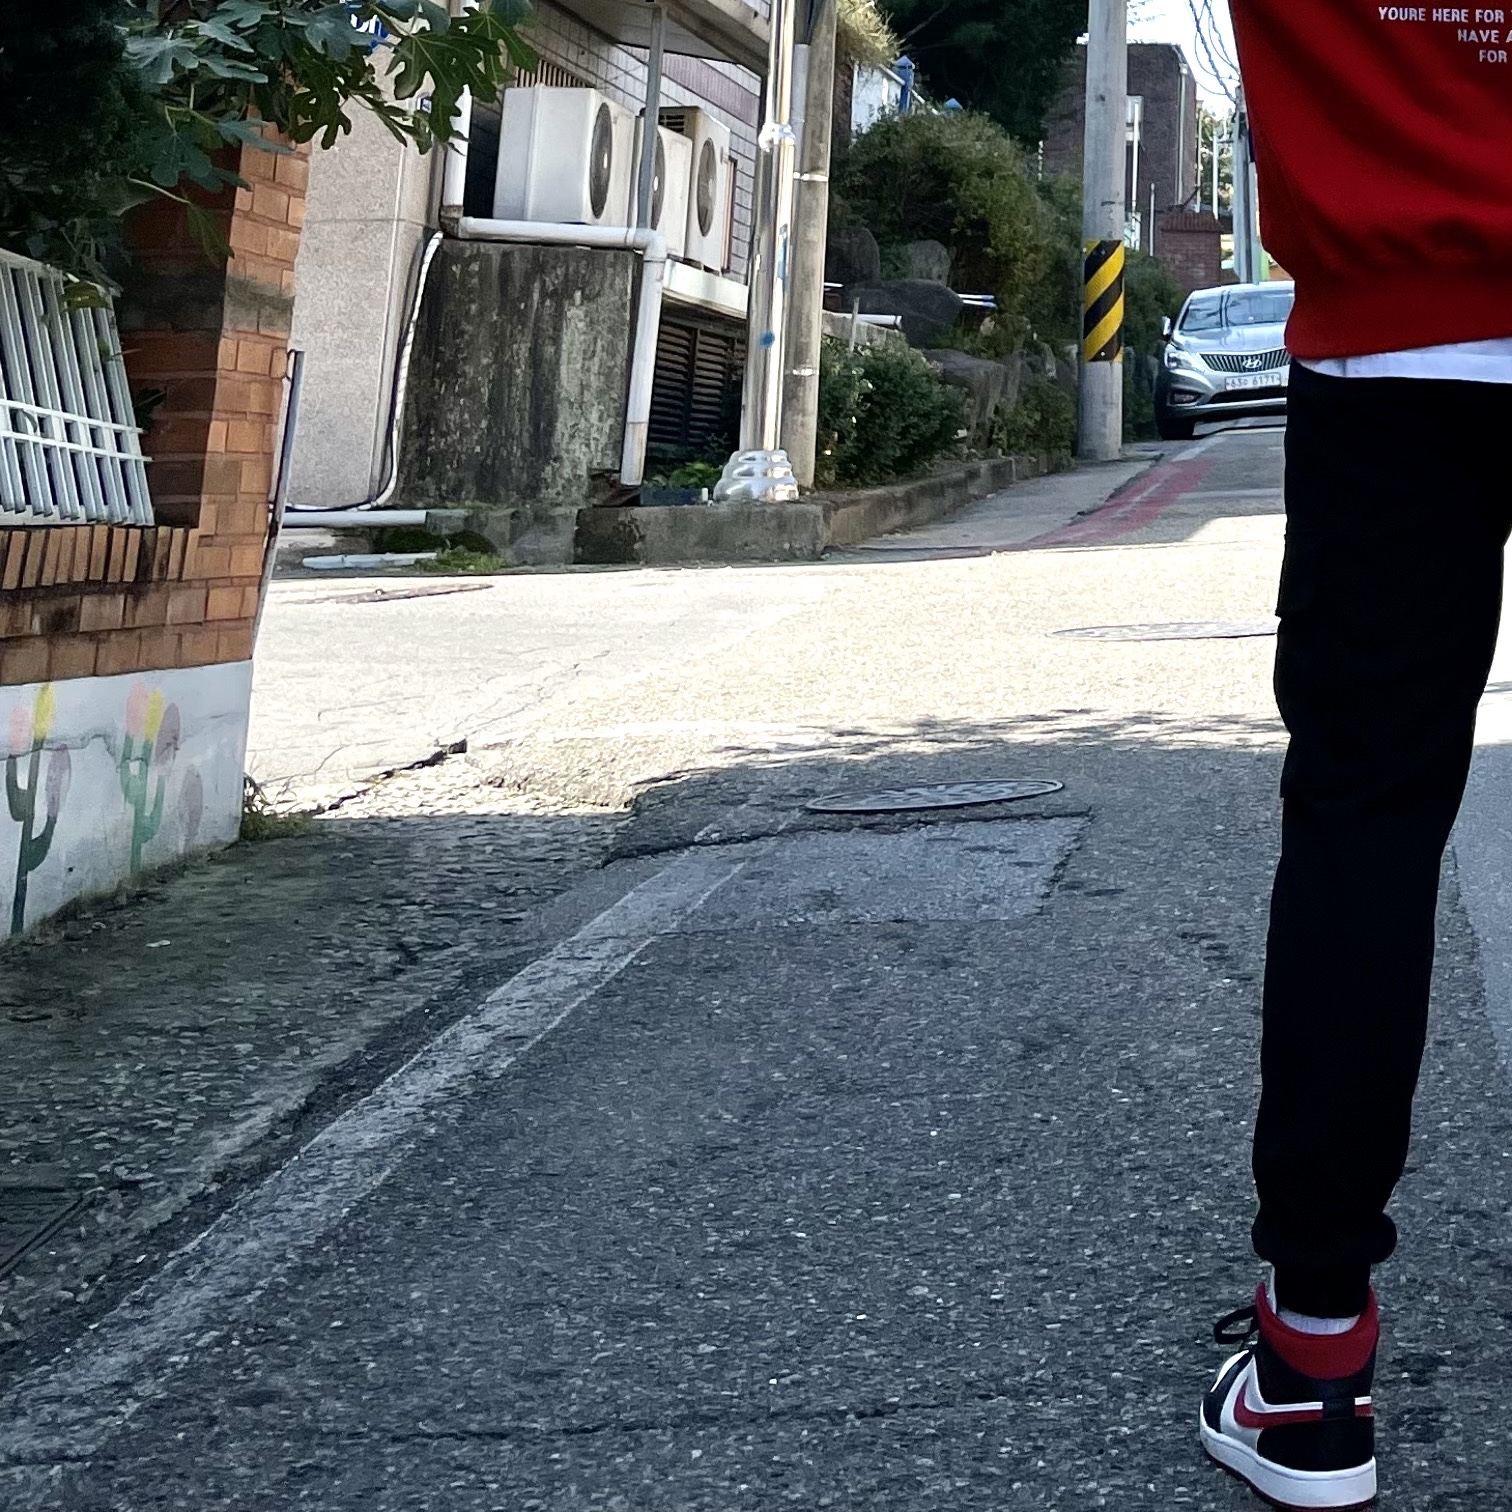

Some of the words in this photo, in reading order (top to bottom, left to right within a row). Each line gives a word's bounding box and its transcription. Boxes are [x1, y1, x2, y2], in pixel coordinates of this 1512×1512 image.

[1379, 7, 1426, 21] YOURE
[1432, 8, 1468, 22] HERE
[1475, 9, 1504, 23] FOR
[1457, 29, 1500, 43] HAVE
[1479, 49, 1507, 63] FOR
